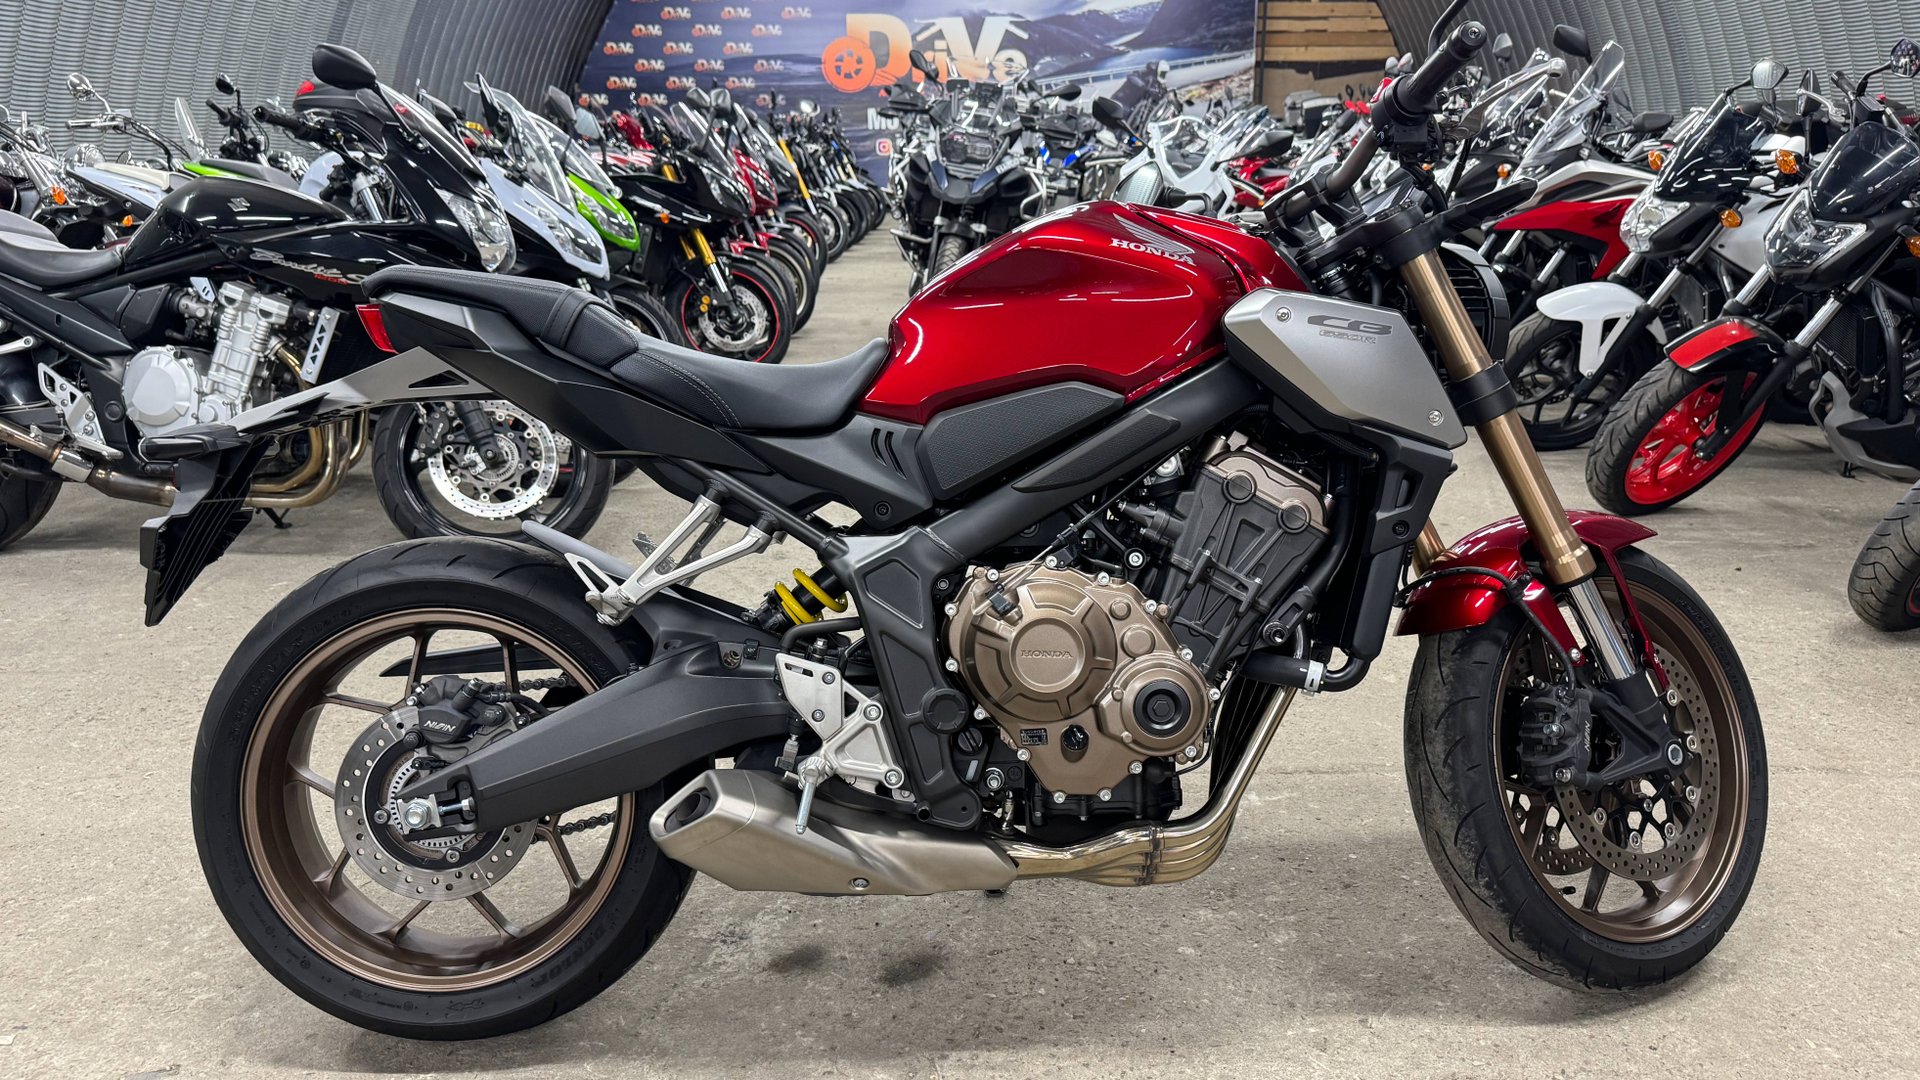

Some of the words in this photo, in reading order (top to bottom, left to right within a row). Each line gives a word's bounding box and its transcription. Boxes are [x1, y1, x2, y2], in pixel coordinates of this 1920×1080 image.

[1109, 237, 1197, 267] HONDA
[1307, 314, 1393, 336] CB
[1021, 649, 1074, 660] HONDA
